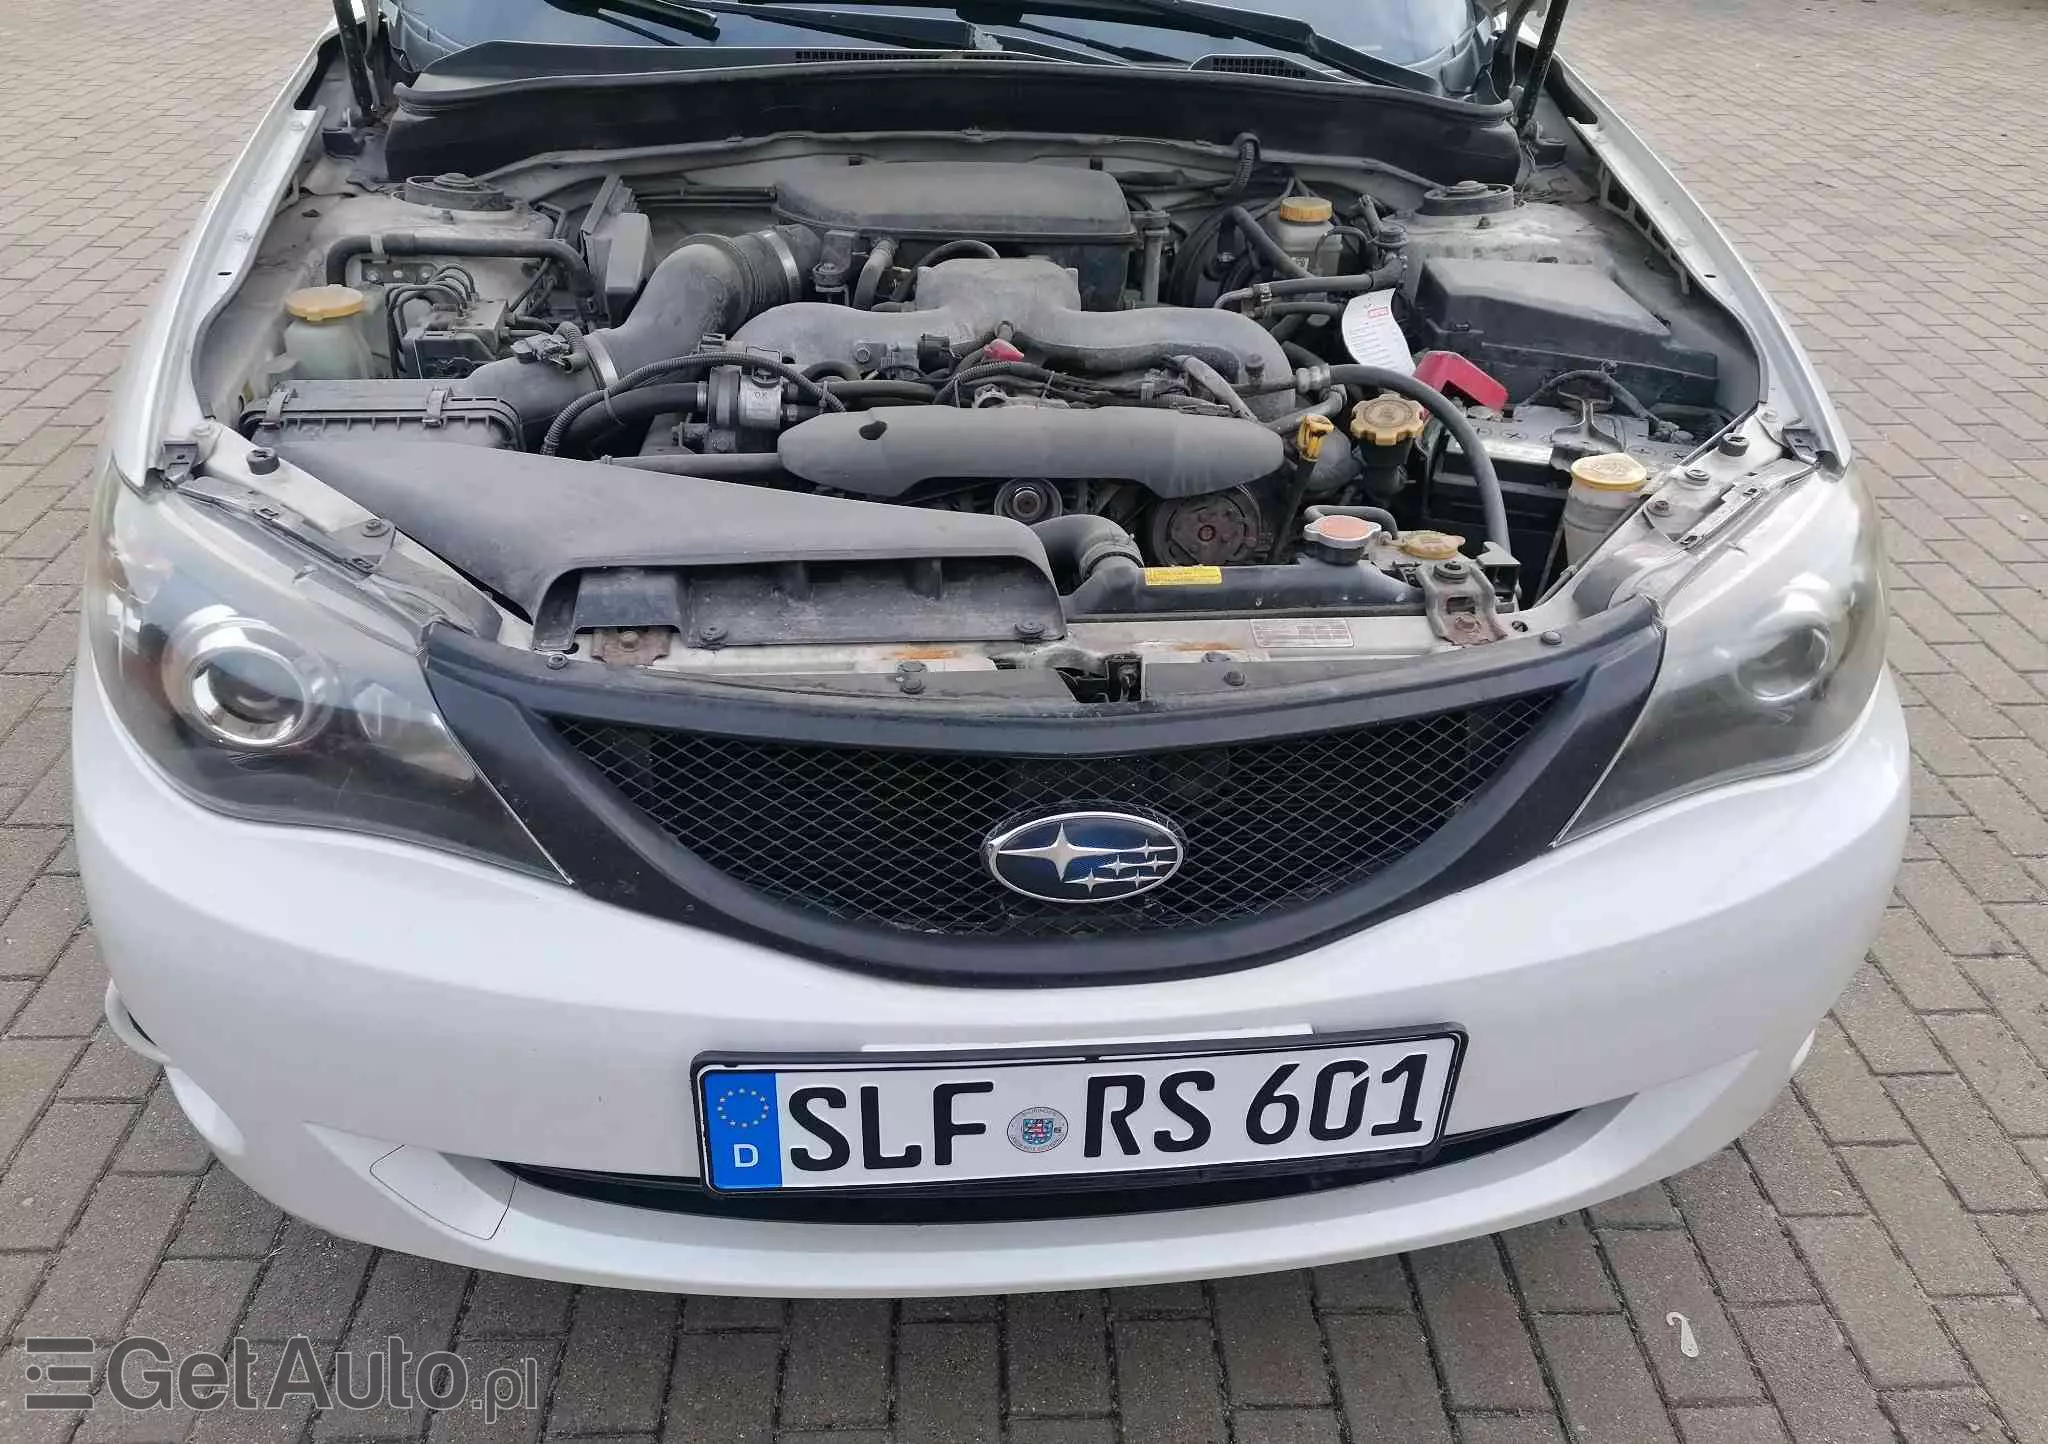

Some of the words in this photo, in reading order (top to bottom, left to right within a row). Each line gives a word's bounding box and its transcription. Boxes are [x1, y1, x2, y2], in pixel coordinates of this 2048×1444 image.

[789, 1082, 993, 1171] SLF
[1084, 1071, 1215, 1158] RS
[1246, 1054, 1427, 1145] 601
[735, 1143, 759, 1169] D
